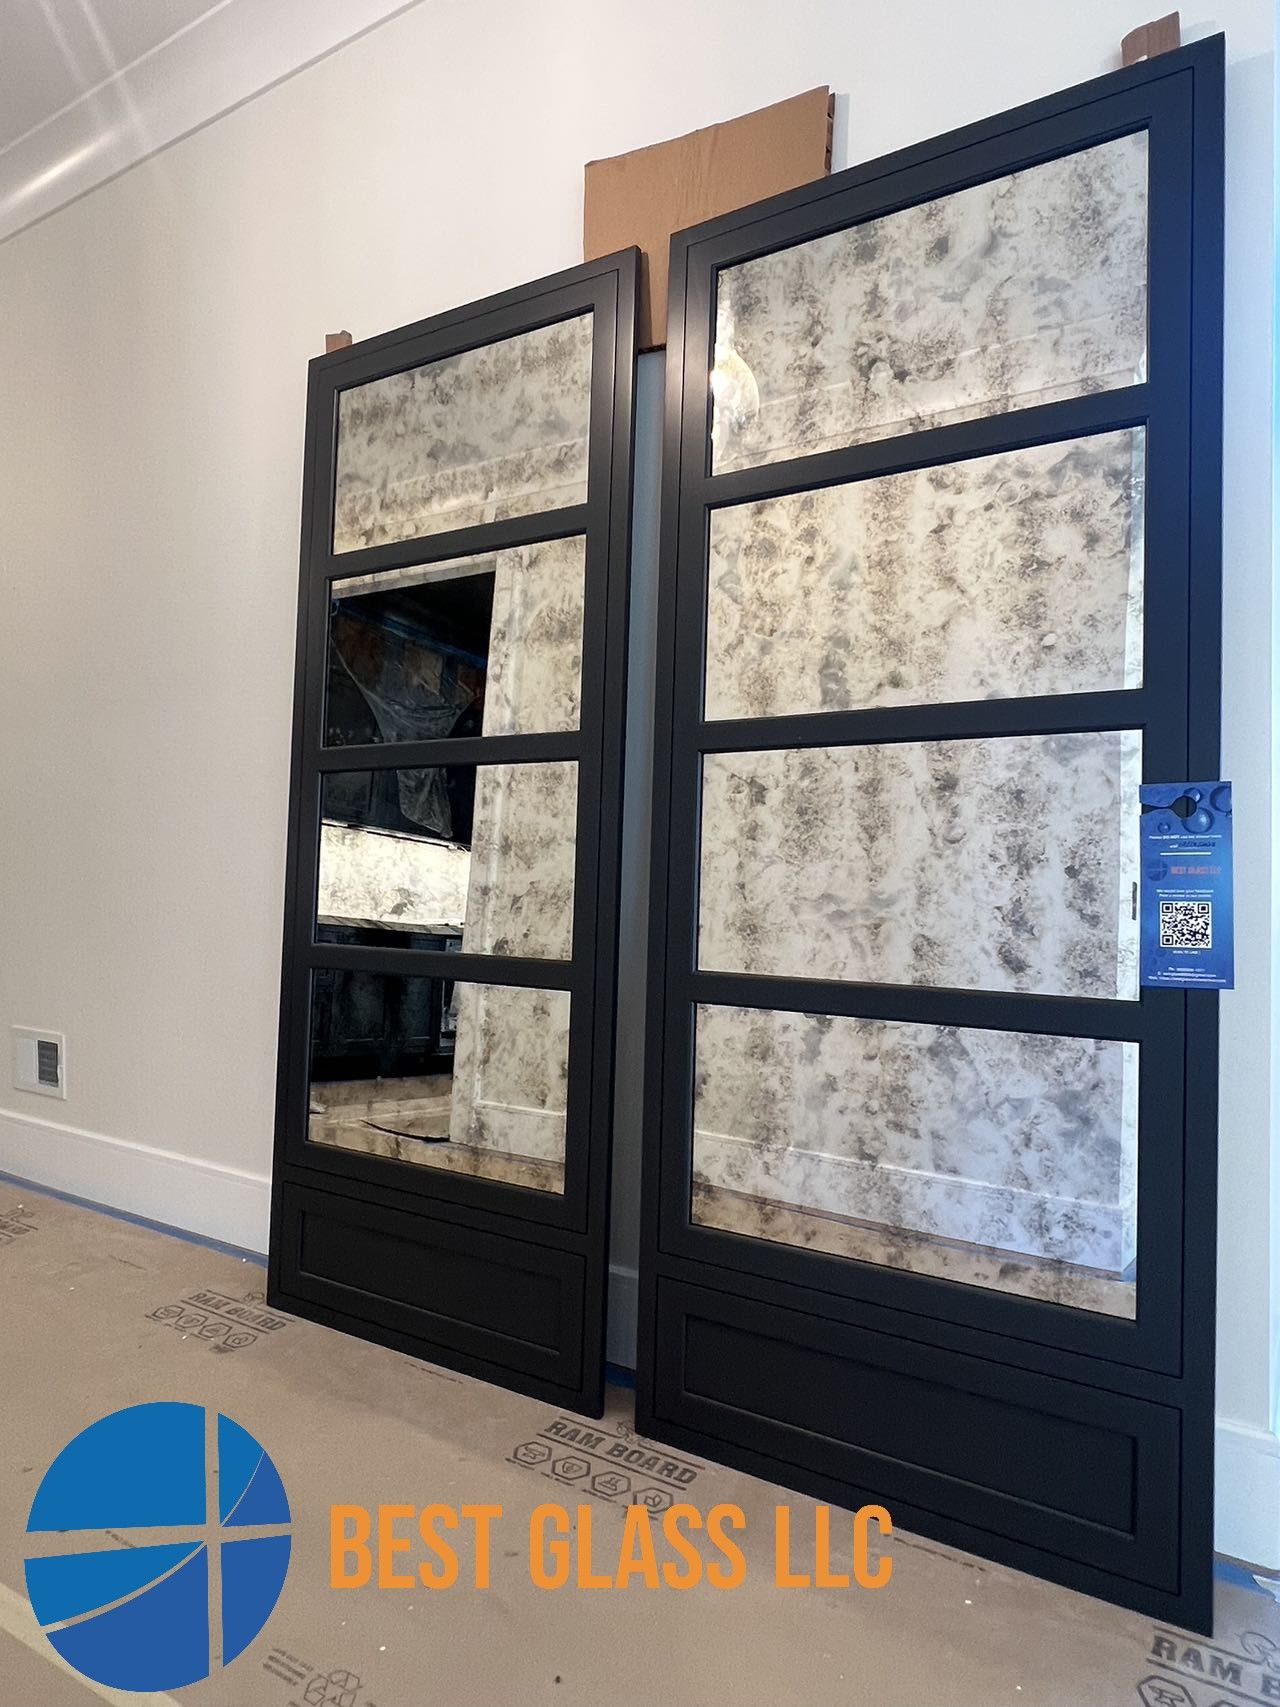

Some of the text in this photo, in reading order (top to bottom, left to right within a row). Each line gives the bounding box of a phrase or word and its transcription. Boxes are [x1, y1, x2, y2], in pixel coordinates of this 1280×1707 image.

[188, 1292, 230, 1311] RAM
[543, 1419, 605, 1450] RAM
[605, 1444, 699, 1485] BOARD
[1151, 1635, 1243, 1686] RAM
